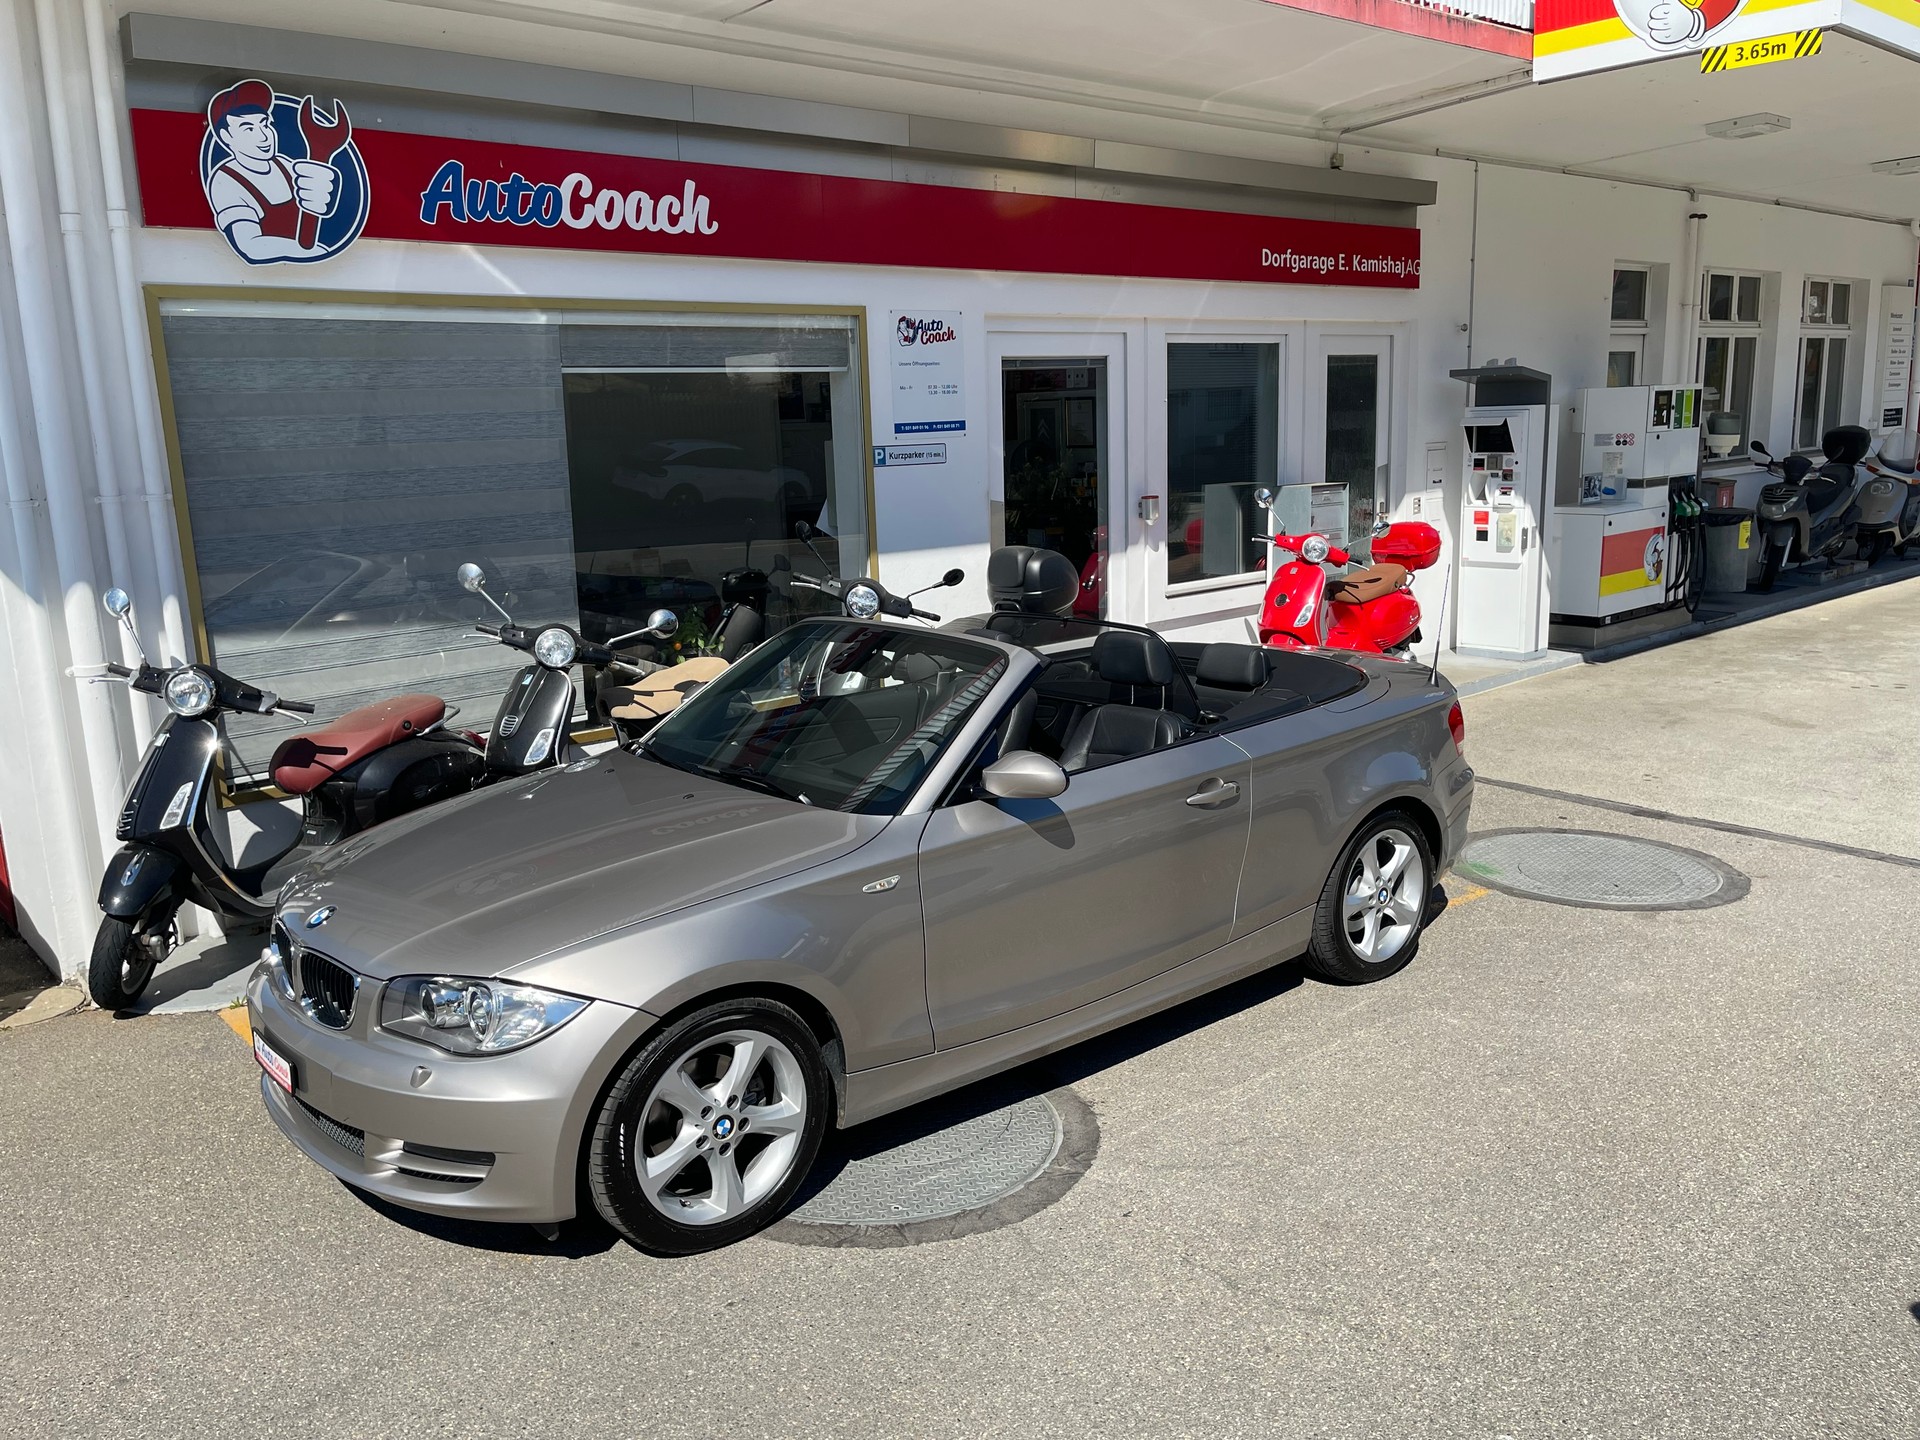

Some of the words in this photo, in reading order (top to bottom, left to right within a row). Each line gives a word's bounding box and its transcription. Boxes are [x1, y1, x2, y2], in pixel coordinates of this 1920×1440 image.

[1735, 42, 1787, 62] 3.65m
[420, 159, 719, 235] AutoCoach
[1261, 248, 1335, 274] Dorfgarage
[1338, 253, 1349, 271] E.
[1352, 254, 1405, 278] Kamishaj
[916, 319, 943, 333] Auto
[920, 326, 957, 345] Coach
[1661, 409, 1667, 423] 1
[874, 449, 884, 465] P
[888, 451, 925, 461] Kurzparker
